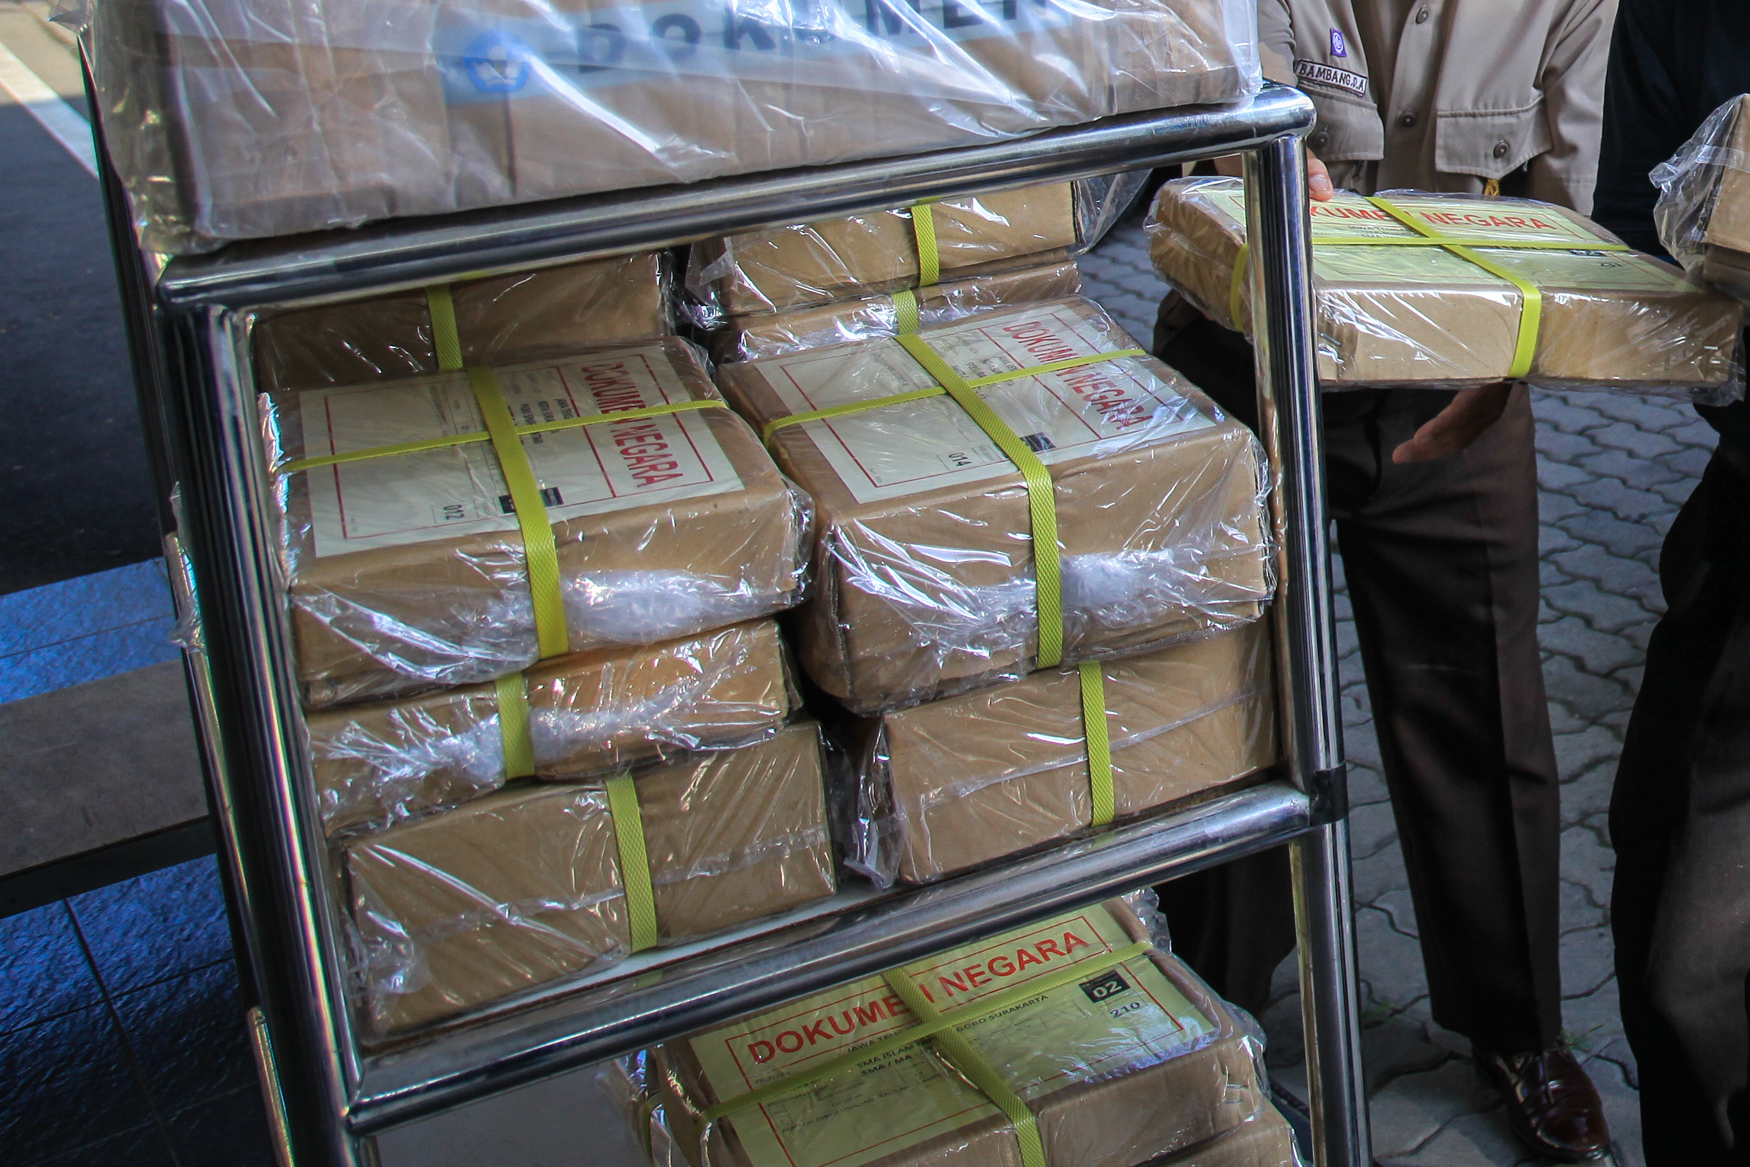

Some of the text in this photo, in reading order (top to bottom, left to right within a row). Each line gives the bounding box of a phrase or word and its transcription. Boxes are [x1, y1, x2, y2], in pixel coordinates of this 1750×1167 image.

[1421, 210, 1556, 231] NEGARA
[1002, 320, 1096, 377] DOKUMN
[1063, 372, 1154, 430] NEGARA
[610, 423, 684, 488] NEGARA
[948, 452, 973, 467] 014
[443, 504, 465, 520] 012
[747, 931, 1091, 1065] DOKUME NEGARA
[1092, 980, 1123, 999] 02
[1110, 1001, 1142, 1019] 210
[857, 1056, 881, 1069] SMA
[883, 1043, 915, 1060] ISLAM
[989, 995, 1050, 1022] SURAKARTA
[861, 1064, 886, 1075] SMA
[894, 1054, 913, 1065] MA
